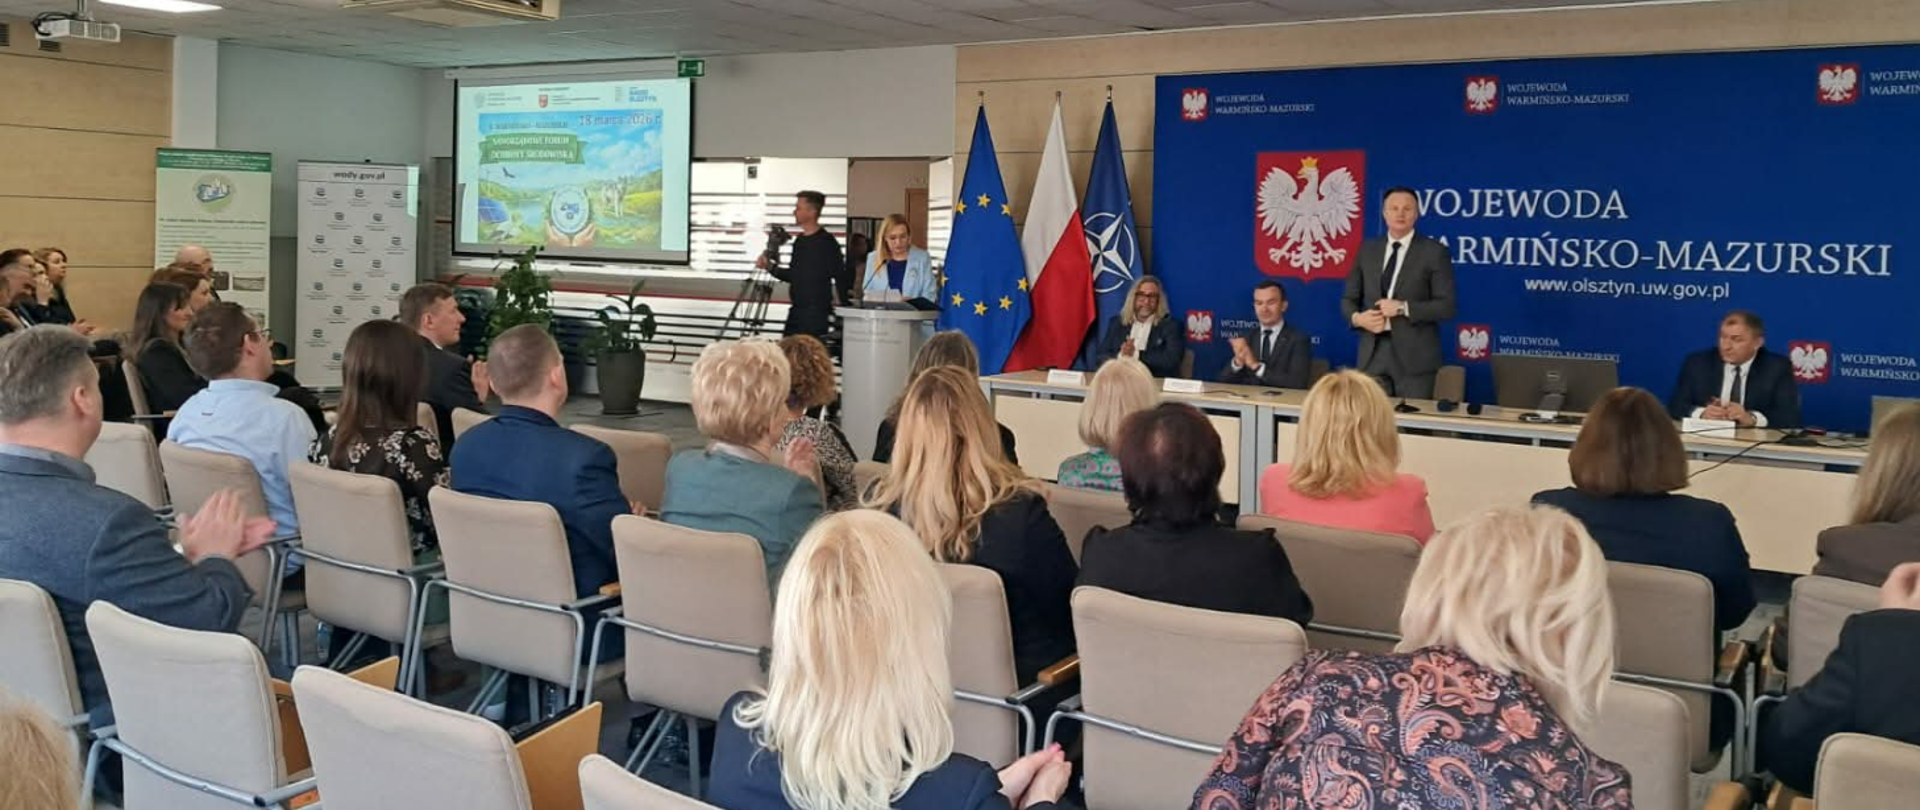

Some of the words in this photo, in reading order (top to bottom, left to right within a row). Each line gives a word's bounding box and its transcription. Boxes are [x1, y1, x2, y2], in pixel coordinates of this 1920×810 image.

[1869, 70, 1920, 81] WOJEW
[1507, 82, 1568, 93] WOJEWODA
[333, 171, 386, 181] wody.gov.pl
[1525, 277, 1730, 300] www.olsztyn.uw.gov.pl
[1499, 335, 1560, 347] WOJEWODA
[1840, 353, 1917, 367] WOJEWODA
